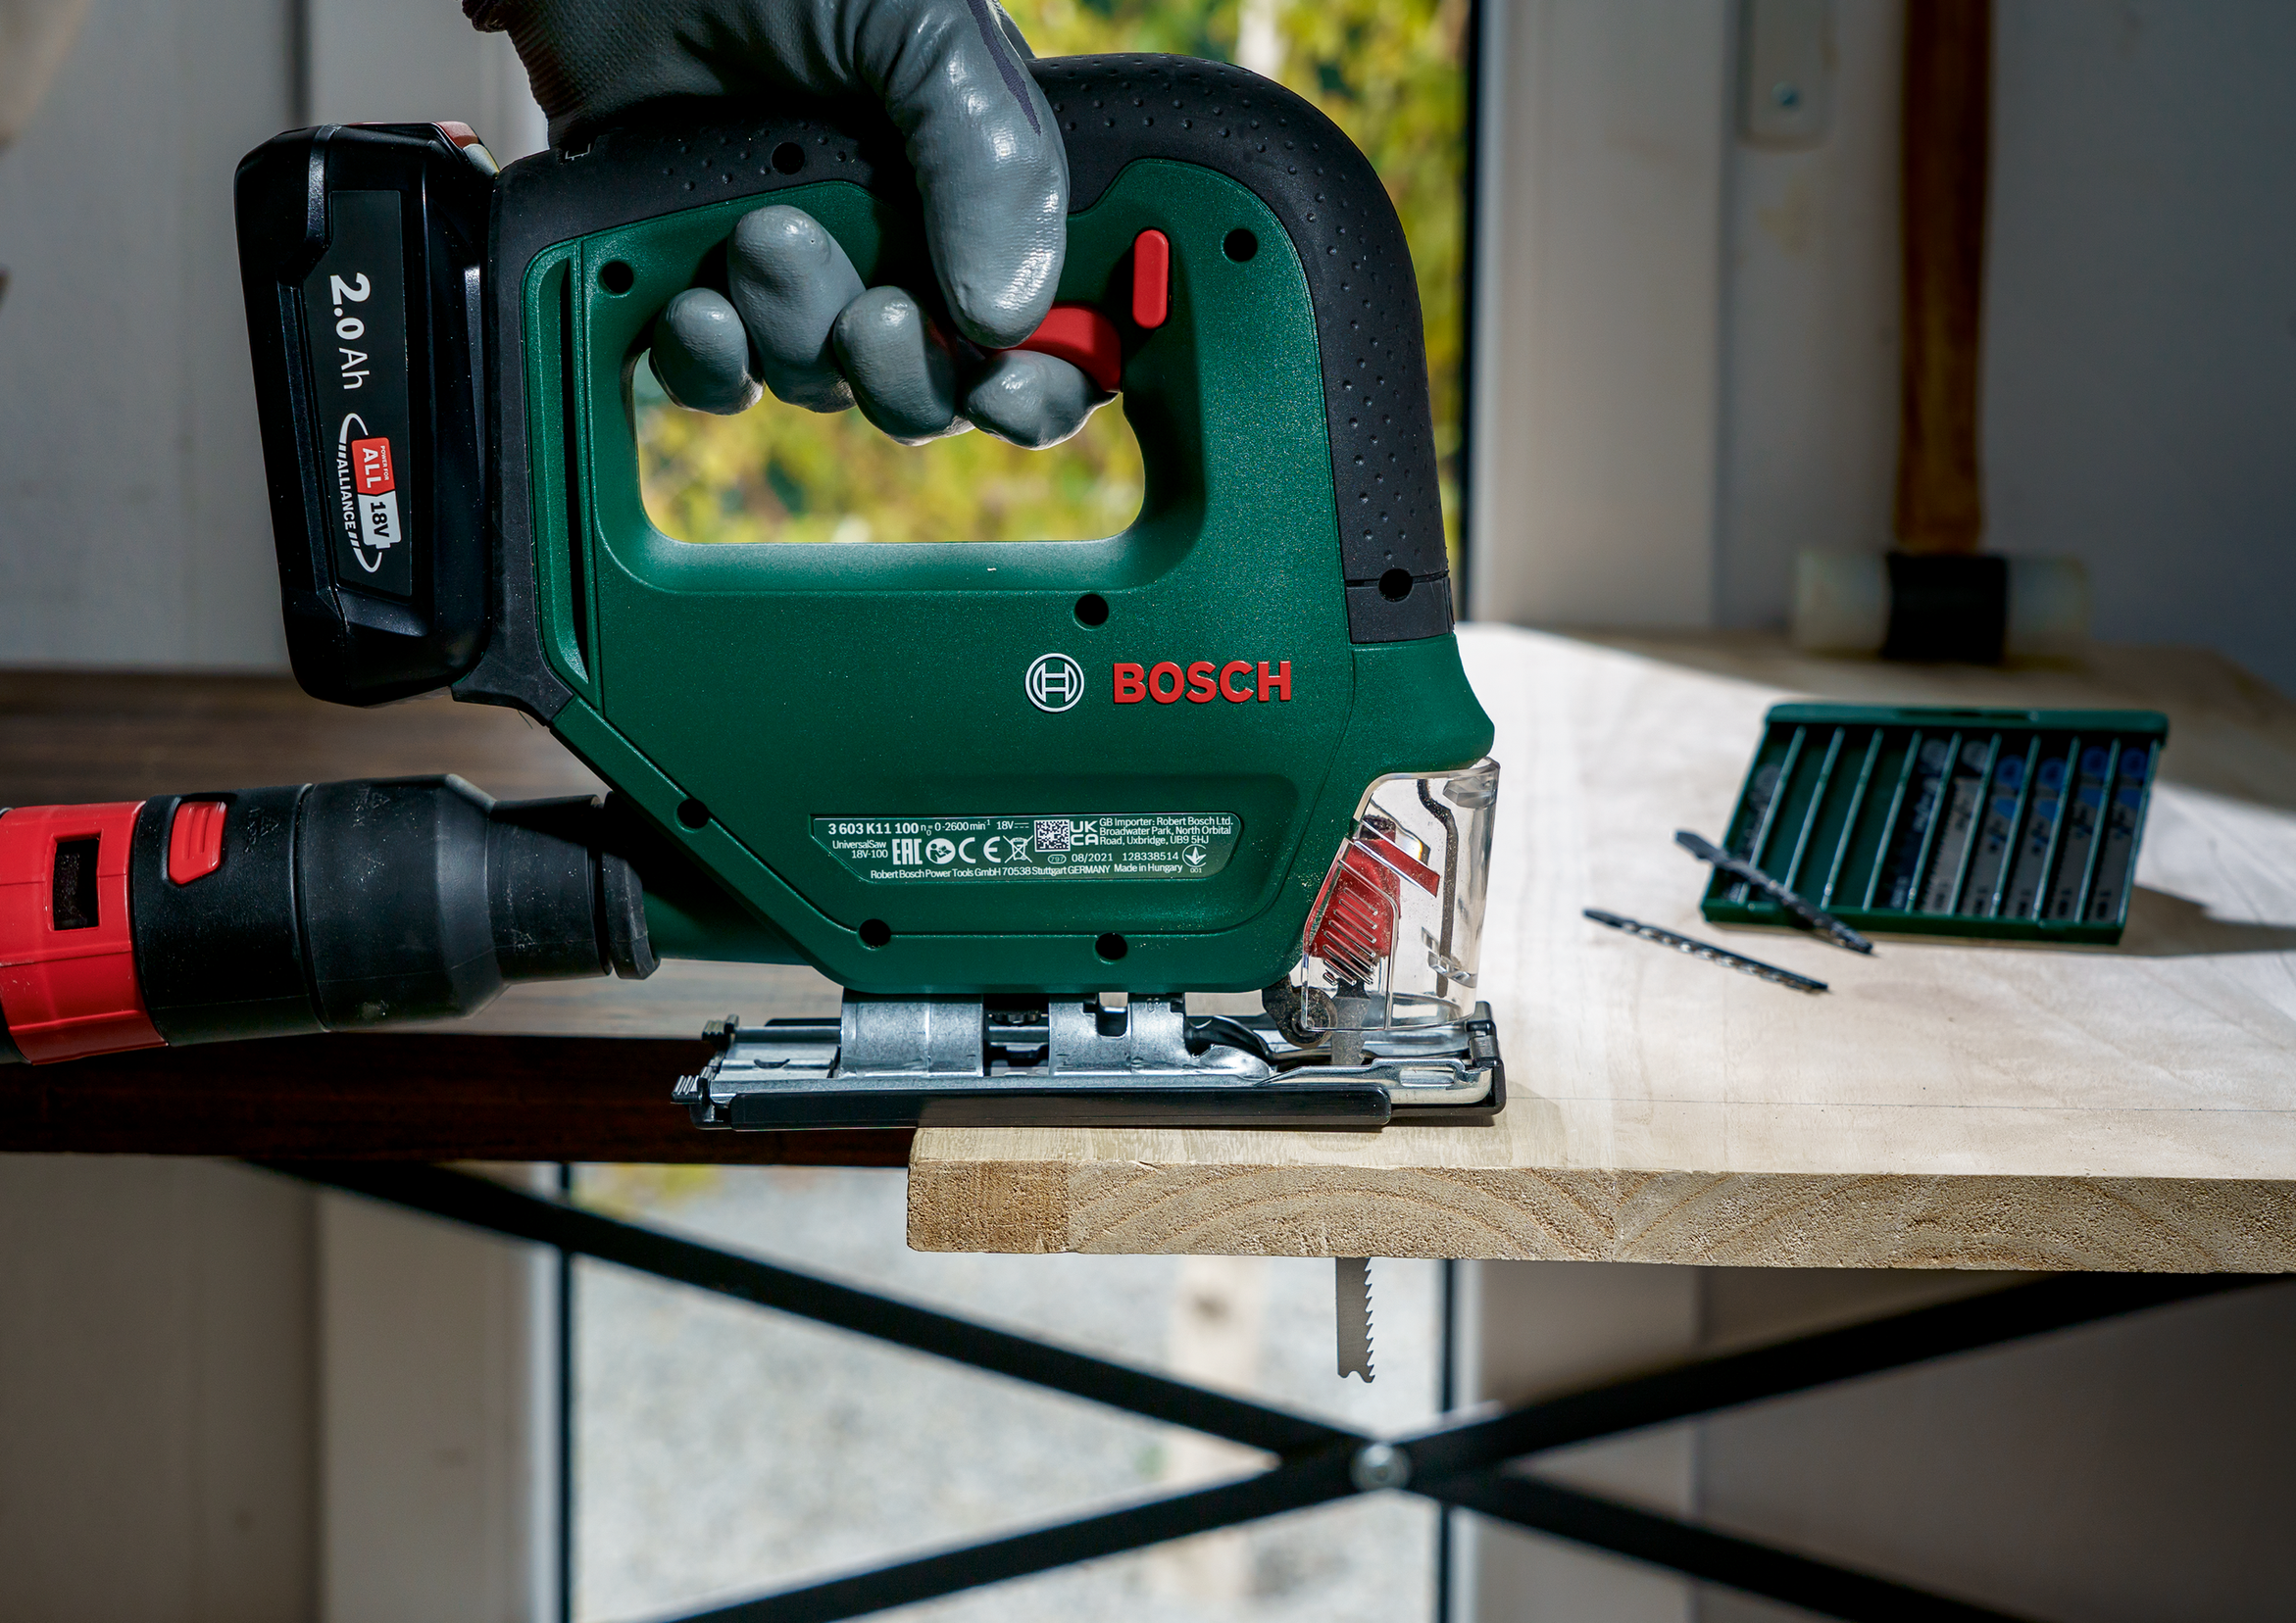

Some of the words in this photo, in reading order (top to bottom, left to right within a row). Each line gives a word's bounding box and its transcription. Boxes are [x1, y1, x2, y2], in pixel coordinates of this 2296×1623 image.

[329, 272, 371, 339] 2.0
[339, 347, 370, 389] Ah
[363, 448, 381, 488] ALL
[336, 459, 356, 530] ALLIANCE
[371, 502, 390, 537] 18V
[1113, 660, 1292, 704] BOSCH
[827, 823, 836, 834] 3
[838, 823, 864, 834] 603
[867, 823, 891, 834] K11
[895, 822, 919, 834] 100
[1070, 820, 1097, 832] UK
[1115, 817, 1155, 828] Importer:
[1157, 817, 1186, 826] Robert
[1188, 816, 1215, 825] Bosch
[1216, 816, 1233, 825] Ltd.
[1100, 826, 1150, 836] Broadwater
[1152, 826, 1173, 836] Park,
[832, 840, 886, 849] UniversalSaw
[1071, 834, 1098, 845] CA
[1100, 837, 1125, 846] Road,
[1126, 836, 1168, 846] Uxbridge,
[1191, 835, 1209, 844] 5HJ
[1072, 854, 1113, 862] 08/2021
[1123, 852, 1178, 861] 128338514
[871, 869, 898, 879] Robert
[899, 869, 924, 878] Bosch
[925, 868, 951, 877] Power
[952, 867, 973, 877] Tools
[974, 867, 1001, 876] GmbH
[1002, 866, 1031, 875] 70538
[1032, 866, 1067, 876] Stuttgart
[1068, 865, 1111, 874] GERMANY
[1148, 863, 1182, 873] Hungary
